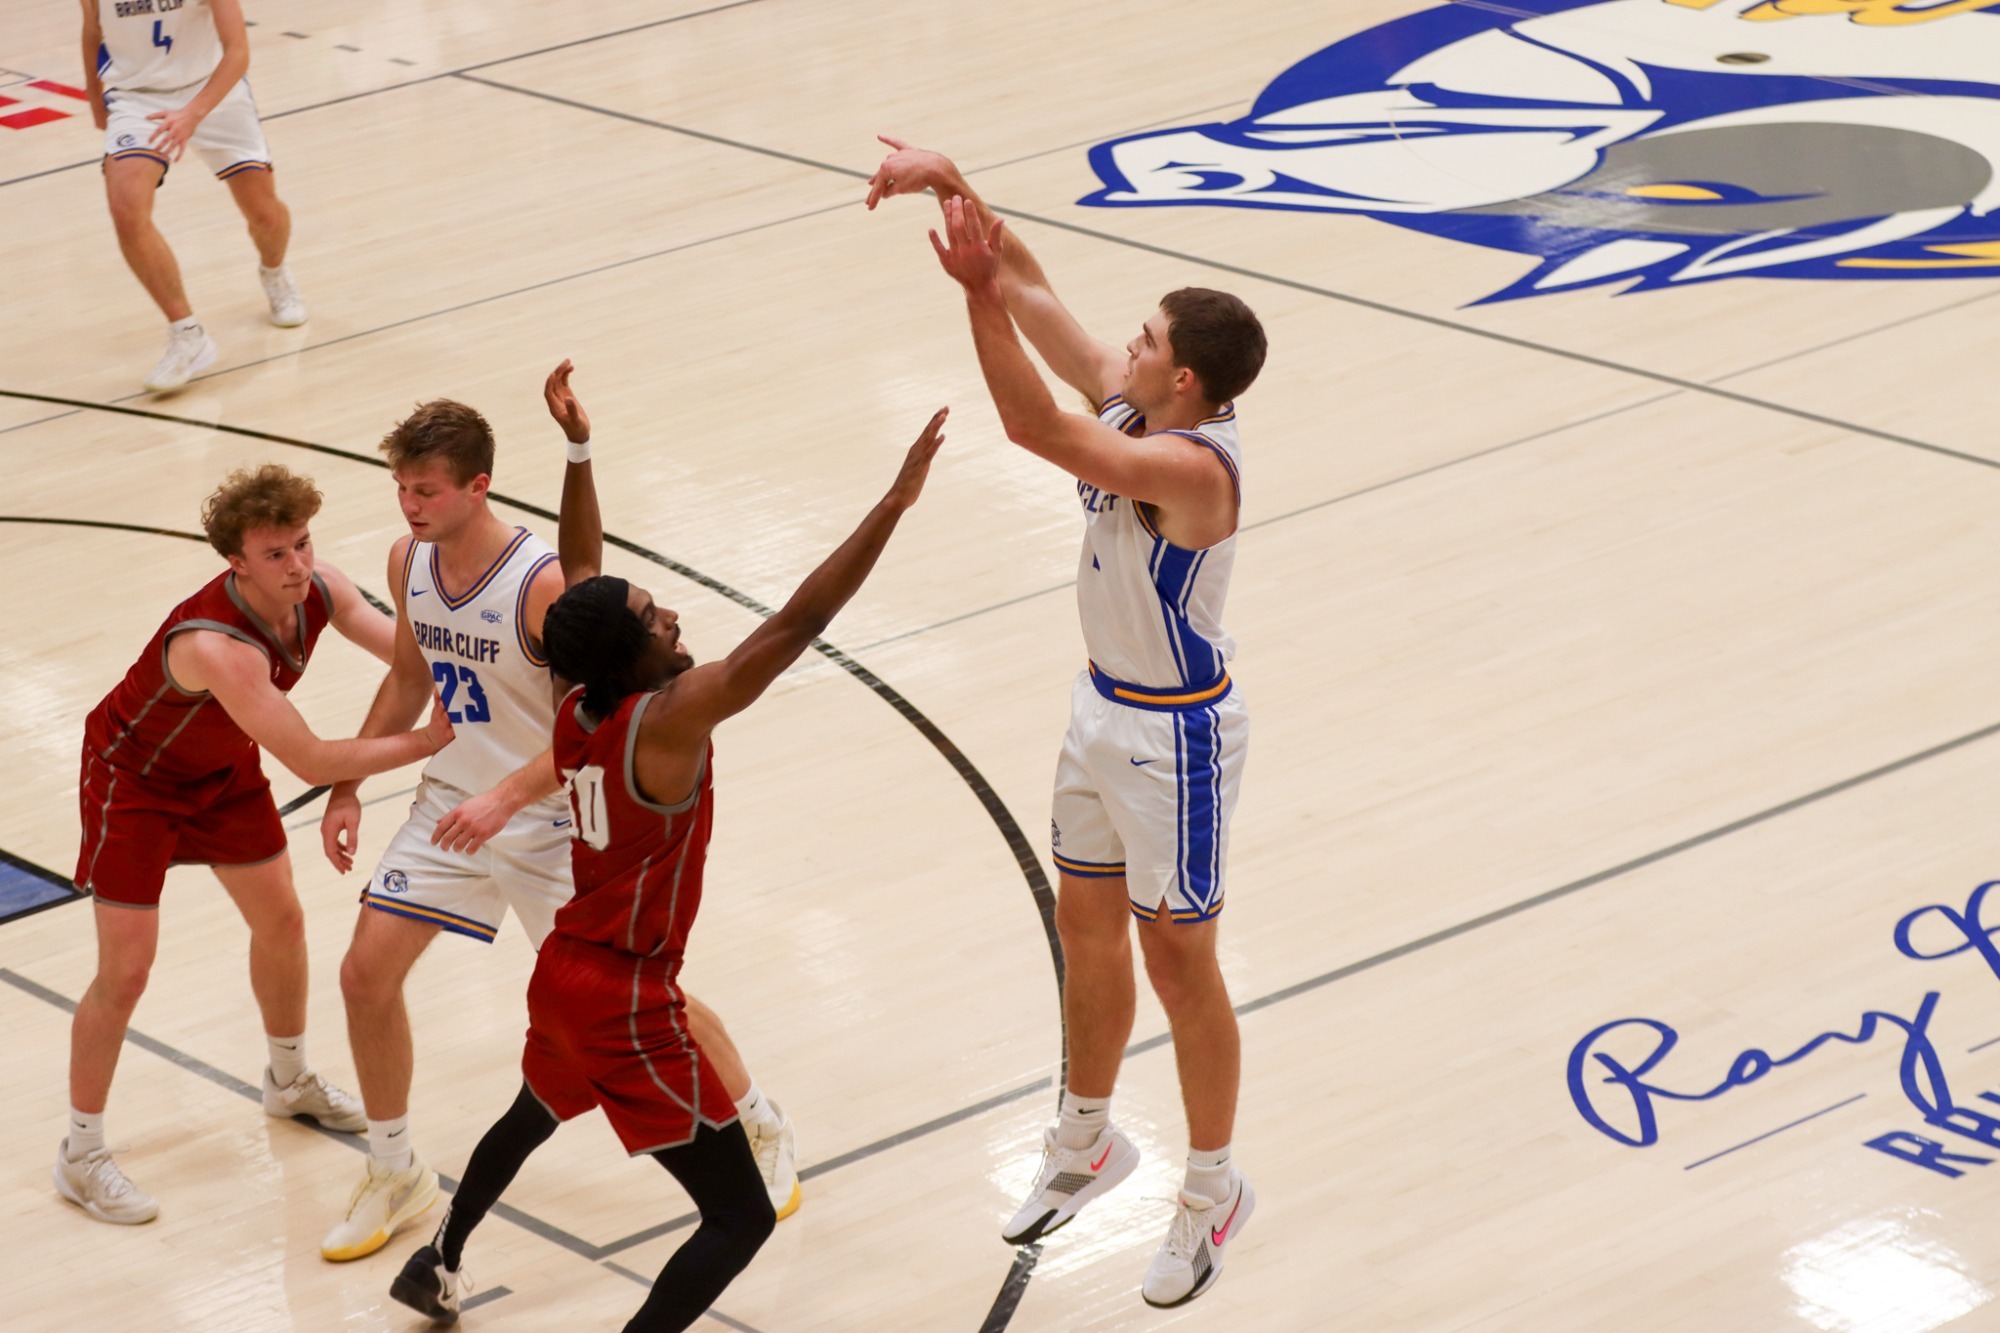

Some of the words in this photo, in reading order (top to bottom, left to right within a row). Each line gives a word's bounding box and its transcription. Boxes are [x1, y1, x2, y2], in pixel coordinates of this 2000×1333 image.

[115, 0, 155, 17] BRIAR
[153, 20, 173, 55] 4
[481, 611, 502, 622] GPAC
[414, 620, 454, 653] BRIAR
[456, 632, 500, 663] CLIFF
[432, 661, 491, 723] 23
[1862, 1091, 2000, 1178] RA
